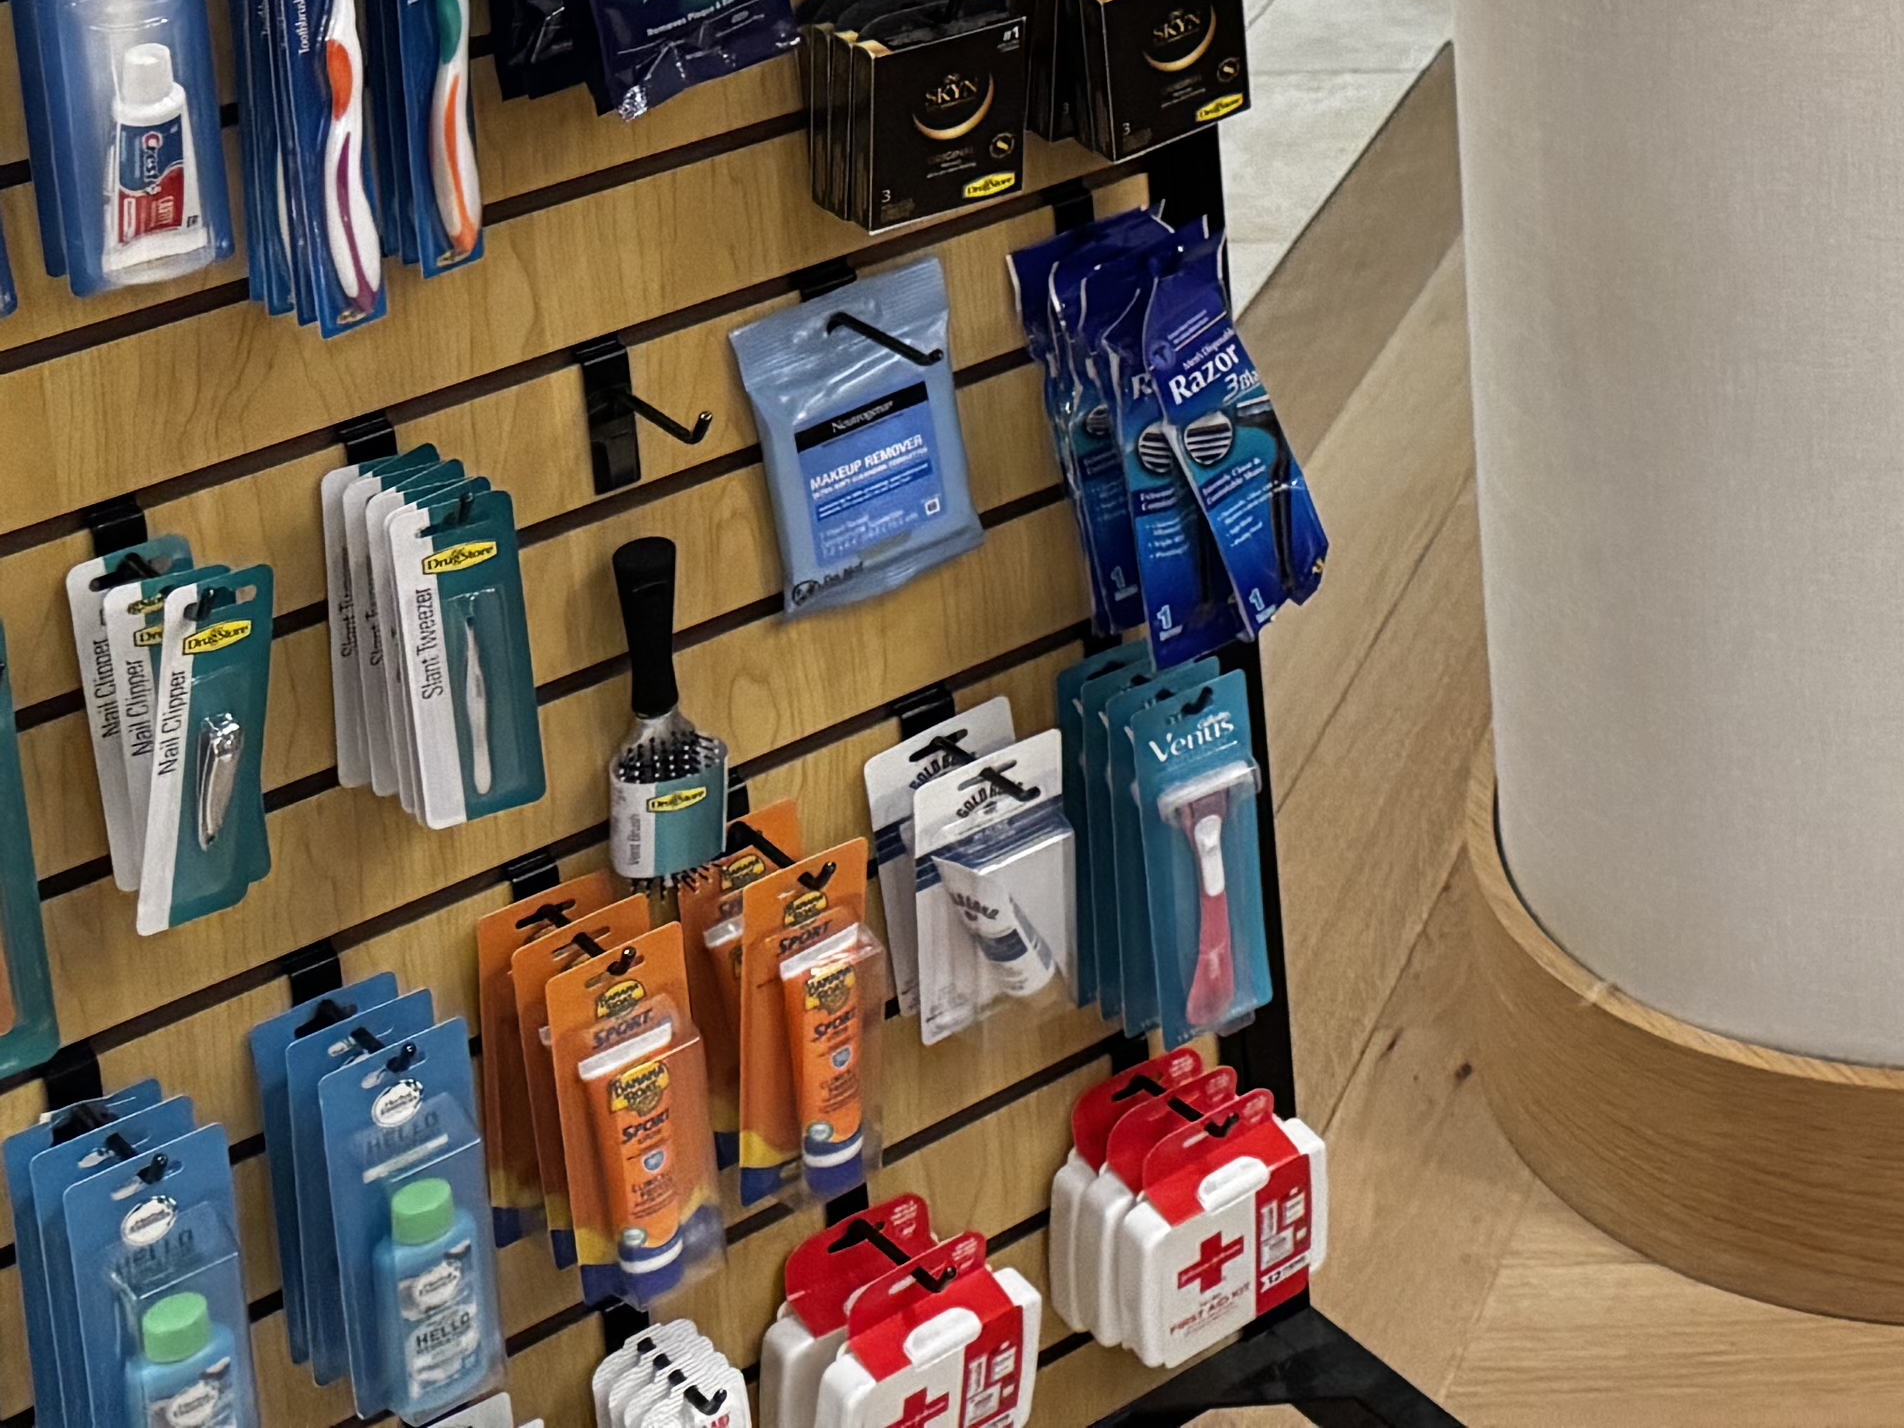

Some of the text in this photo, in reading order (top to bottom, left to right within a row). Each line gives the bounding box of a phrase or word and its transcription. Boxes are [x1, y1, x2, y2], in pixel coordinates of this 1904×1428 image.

[1168, 343, 1240, 405] Razor
[414, 588, 445, 700] Slant Tweezer
[157, 669, 188, 776] Nail Clipper
